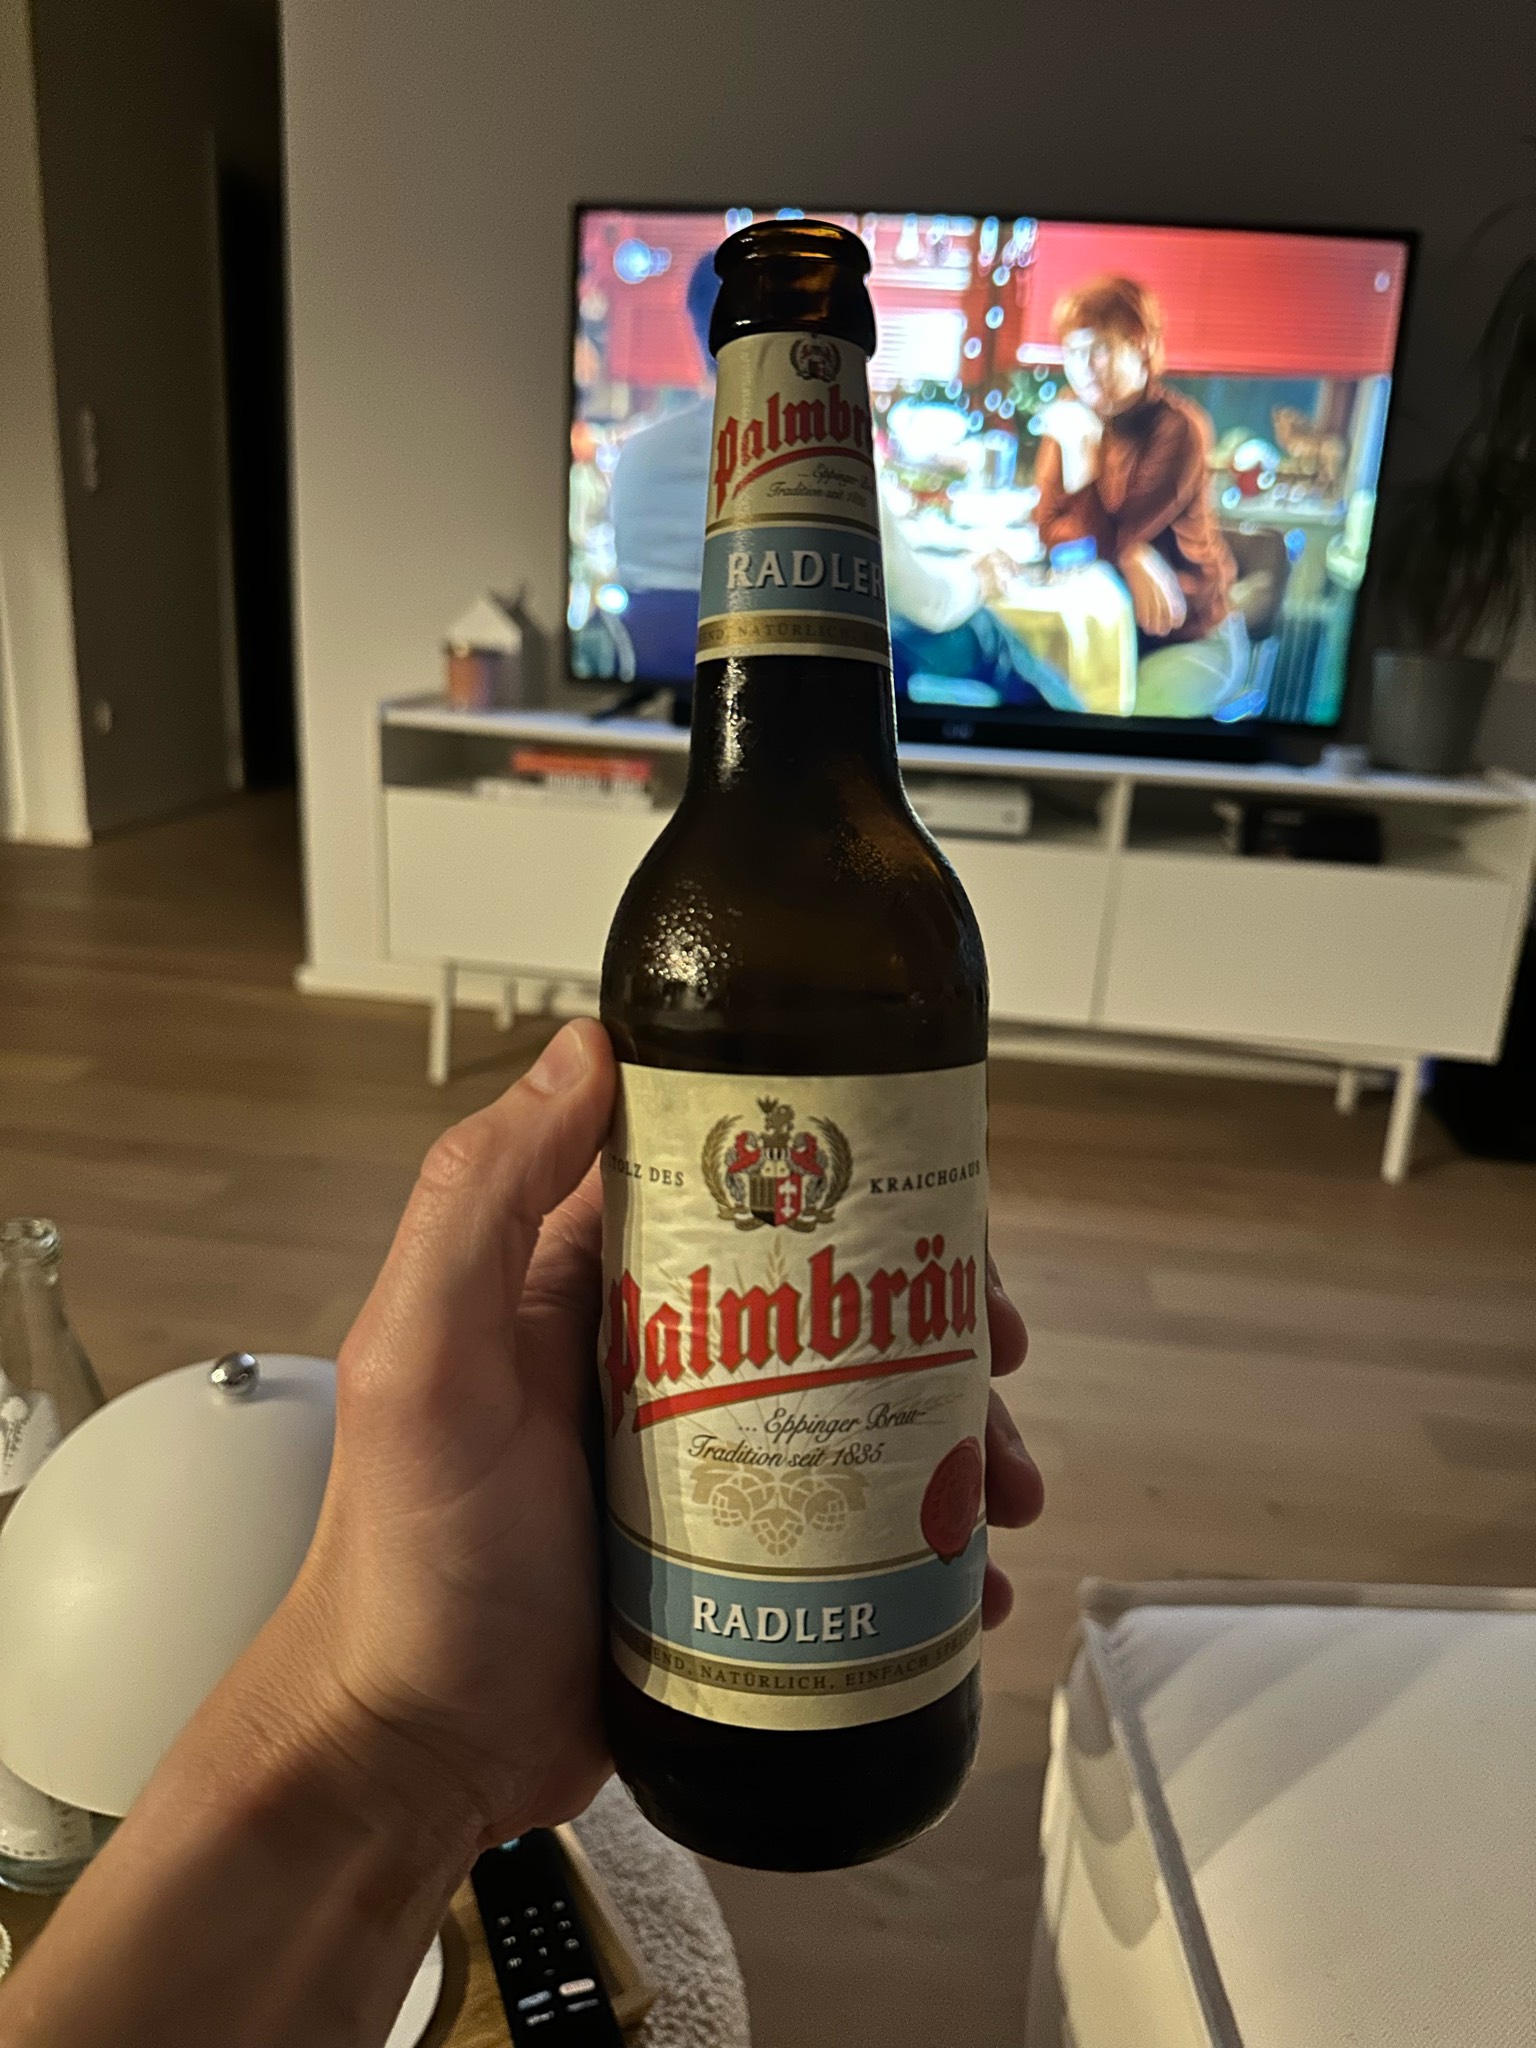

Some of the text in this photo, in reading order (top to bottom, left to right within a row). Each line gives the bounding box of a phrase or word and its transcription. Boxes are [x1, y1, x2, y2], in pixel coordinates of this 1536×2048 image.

[727, 550, 886, 600] RADLER
[649, 1166, 684, 1187] DES
[869, 1160, 980, 1194] KRAICHGAUS
[604, 1233, 977, 1437] Palmbräu
[764, 1408, 863, 1444] Eppinger
[688, 1434, 788, 1467] Tradition
[788, 1447, 827, 1467] seit
[691, 1595, 880, 1643] RADLER
[700, 1665, 836, 1691] NATÜRLICH,
[845, 1652, 929, 1687] EINFACH
